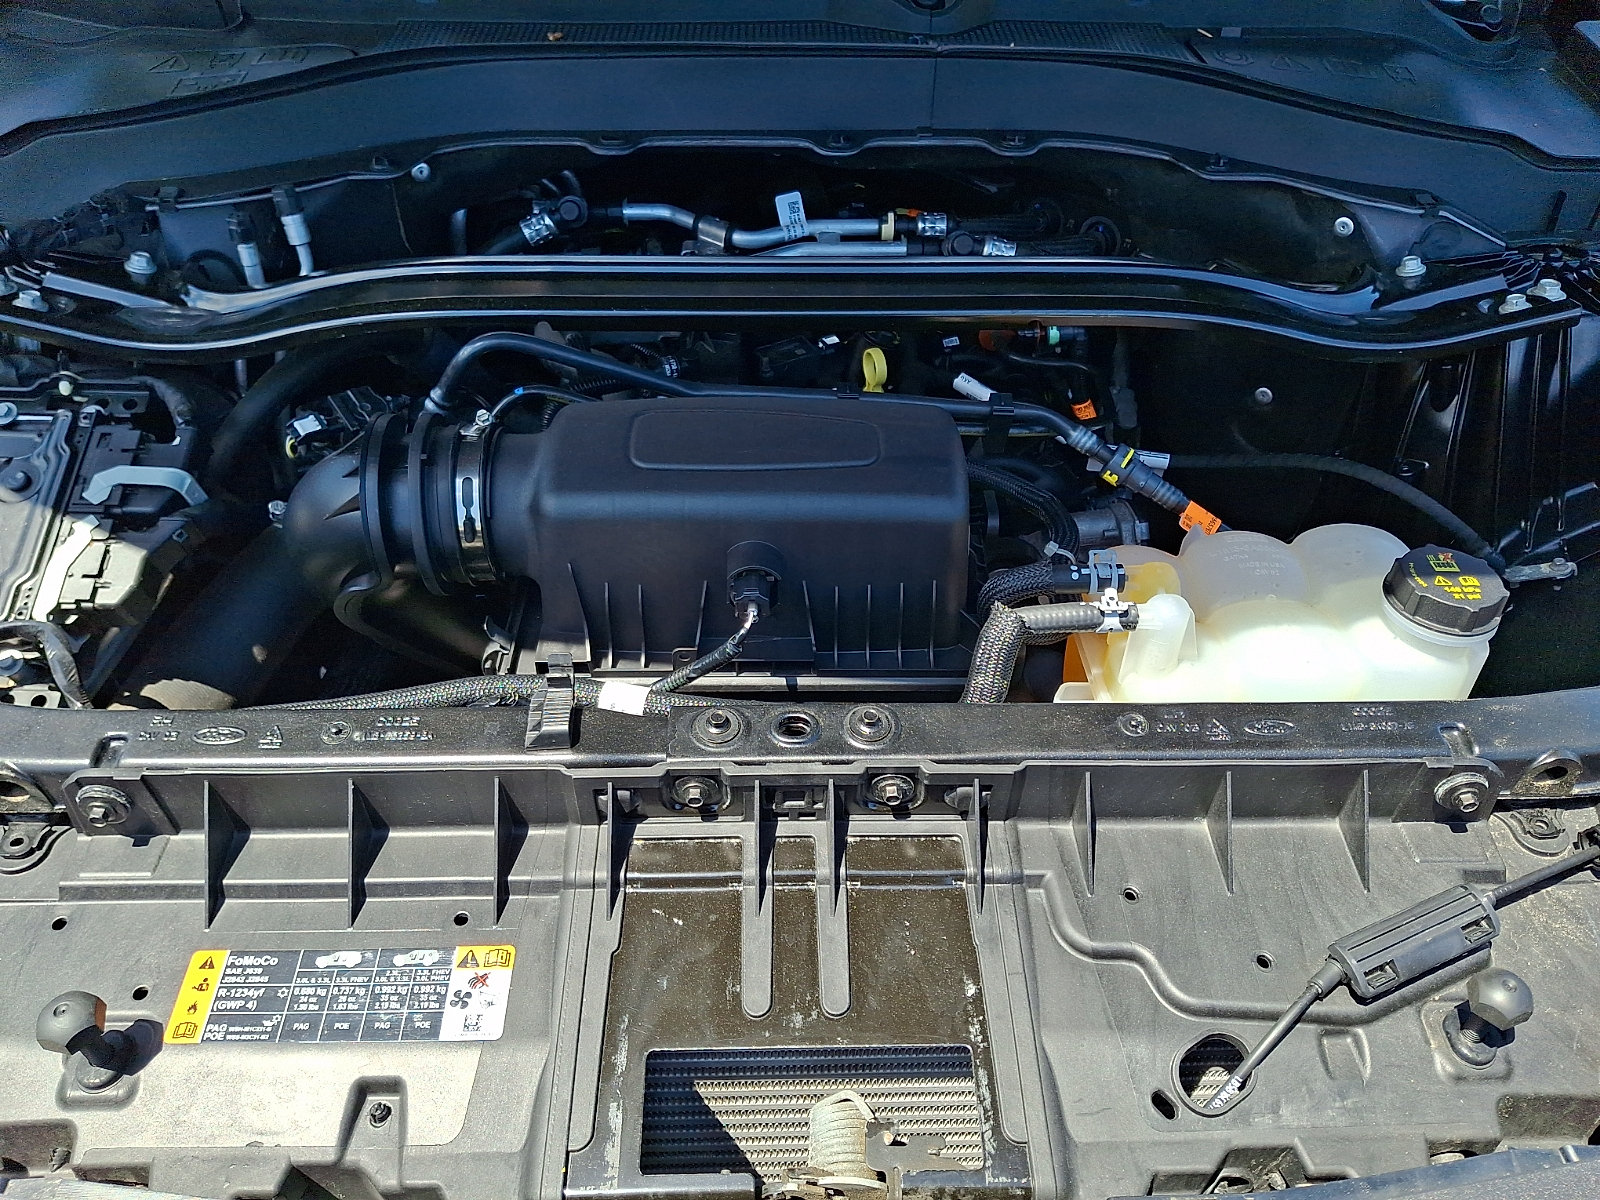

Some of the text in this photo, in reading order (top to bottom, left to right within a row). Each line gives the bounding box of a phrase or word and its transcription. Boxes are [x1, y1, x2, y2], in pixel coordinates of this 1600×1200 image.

[227, 955, 278, 966] FoMoCo
[217, 987, 266, 999] R-1234yf
[316, 987, 328, 996] kg
[333, 987, 366, 996] 0.737 kg
[397, 986, 408, 995] kg
[413, 985, 447, 994] 0.992 kg
[213, 1000, 257, 1011] (GWP 4)
[205, 1023, 228, 1032] PAG
[292, 1022, 310, 1030] PAG
[333, 1022, 350, 1030] POE
[374, 1021, 391, 1029] PAG
[414, 1021, 432, 1029] POE
[203, 1032, 226, 1040] POE
